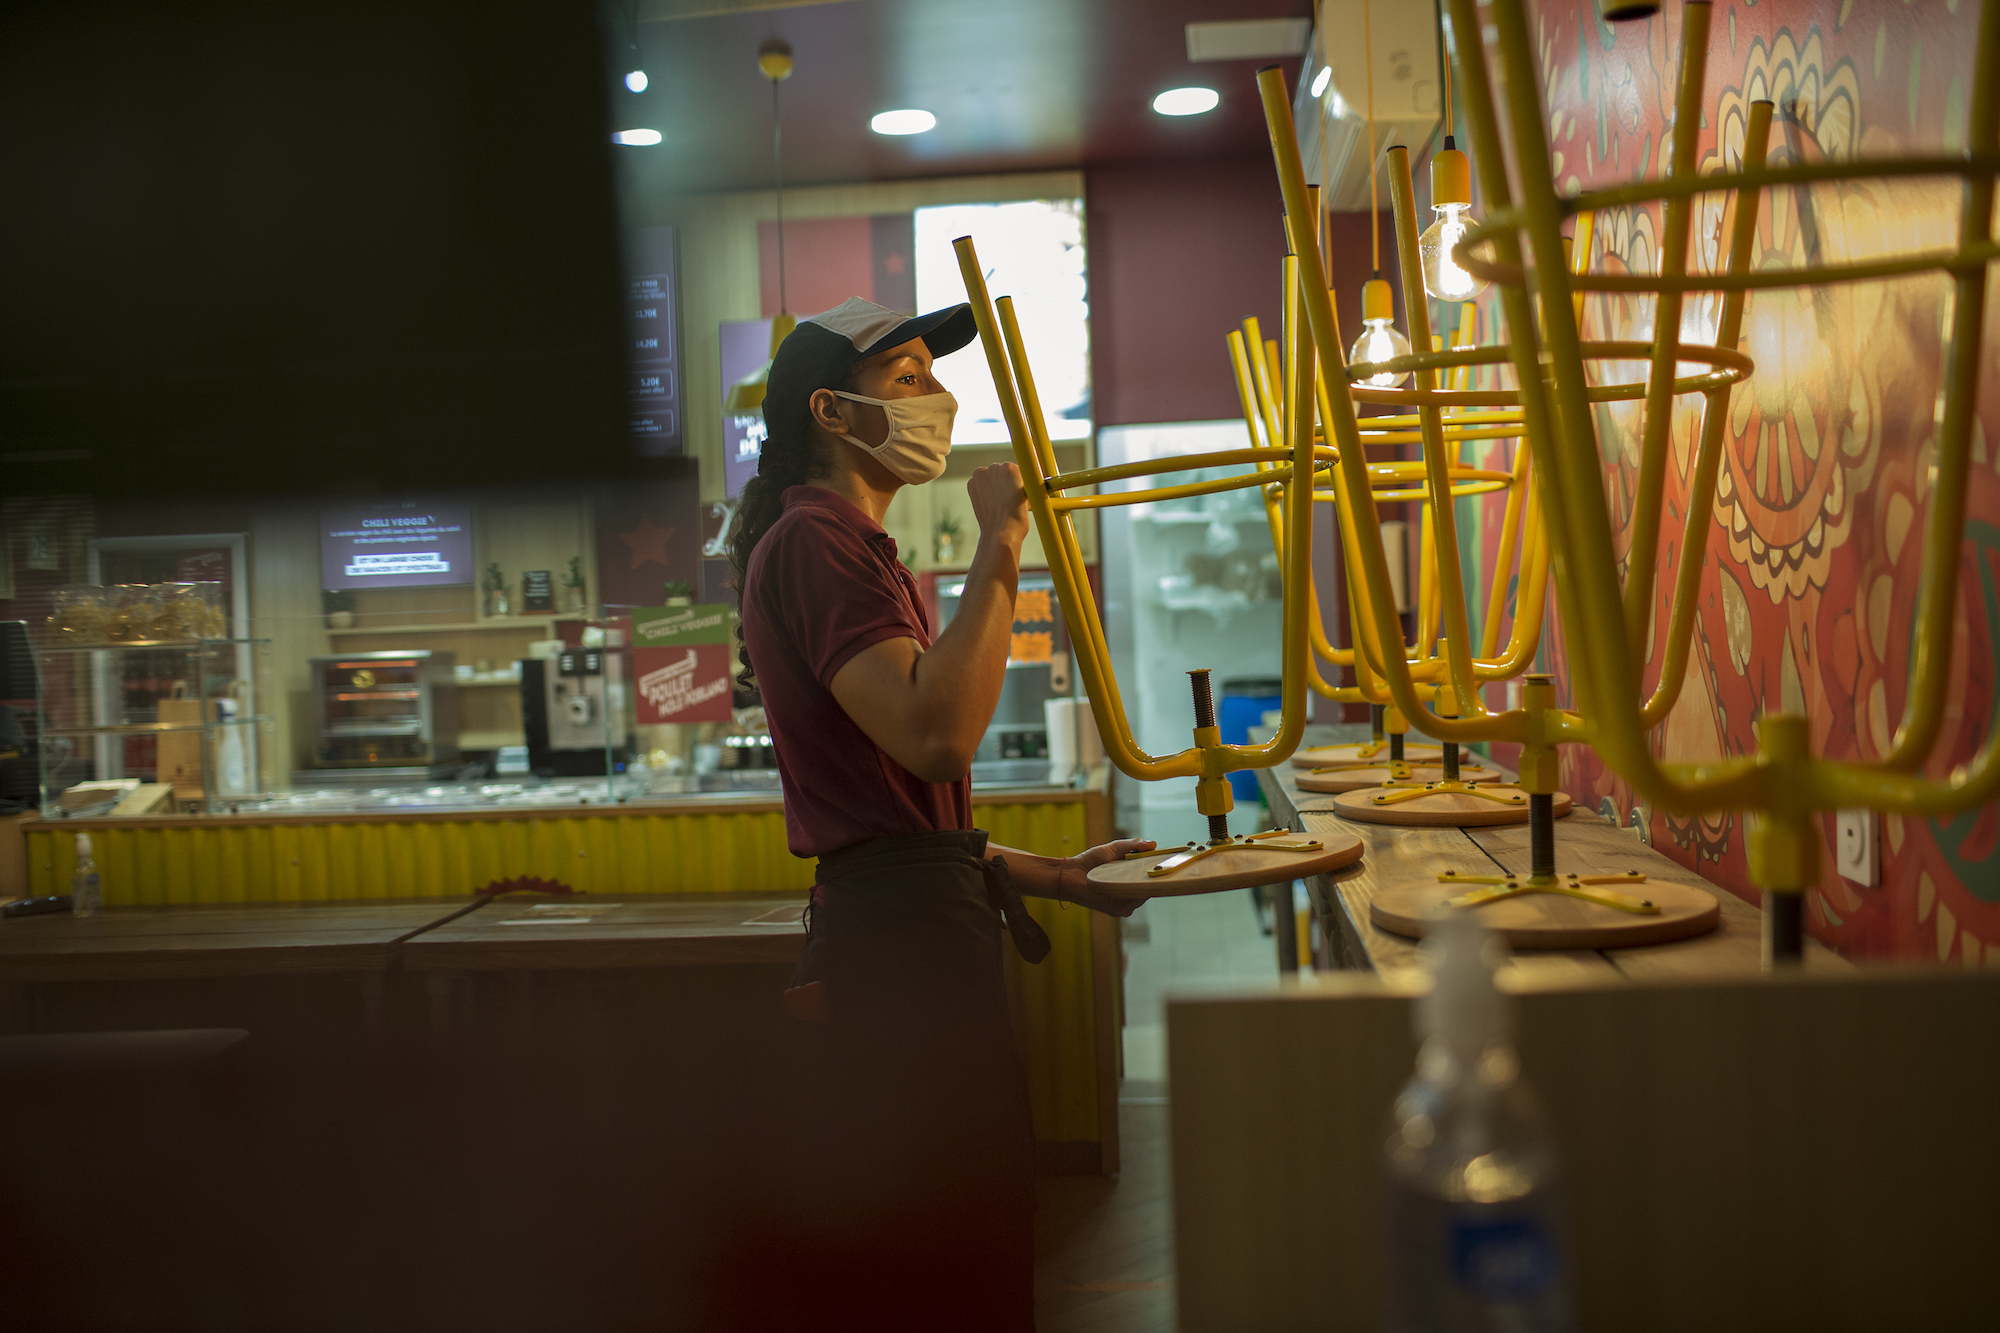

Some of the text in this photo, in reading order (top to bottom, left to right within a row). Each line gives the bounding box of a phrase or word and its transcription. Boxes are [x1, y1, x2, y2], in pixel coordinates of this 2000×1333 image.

[641, 279, 658, 288] TRIO
[635, 307, 657, 319] 11,70€
[635, 337, 658, 349] 14,20€
[640, 376, 660, 387] 5,20€
[361, 517, 428, 528] CHILI VEGGIE
[649, 671, 694, 707] POULET
